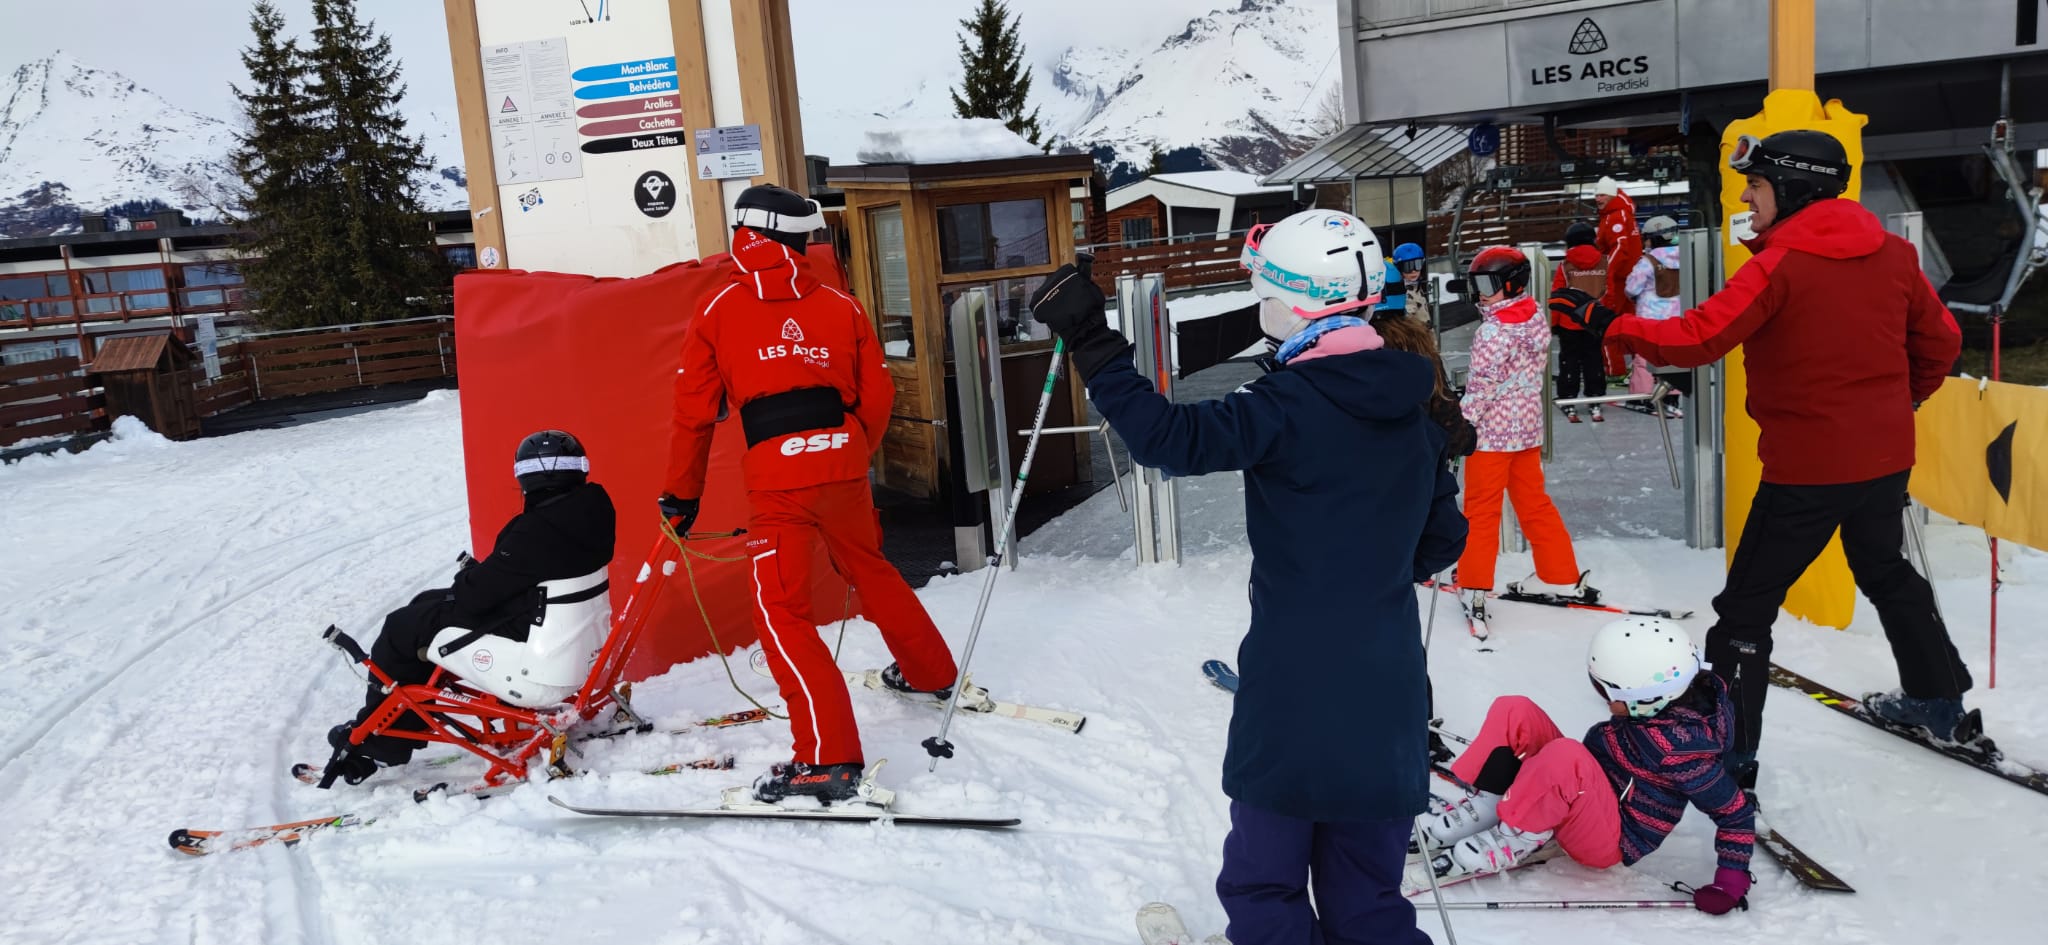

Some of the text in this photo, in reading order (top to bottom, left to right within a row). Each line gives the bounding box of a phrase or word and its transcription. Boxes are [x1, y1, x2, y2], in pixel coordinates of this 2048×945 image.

[621, 61, 669, 75] Mont-Blanc
[1531, 55, 1649, 85] LES ARCS
[629, 79, 671, 93] Belvédère
[1597, 76, 1649, 93] Paradiski
[643, 97, 673, 110] Arolles
[639, 117, 676, 129] Cachette
[631, 135, 678, 149] Deux Têtes
[747, 231, 757, 241] 3
[758, 344, 787, 361] LES
